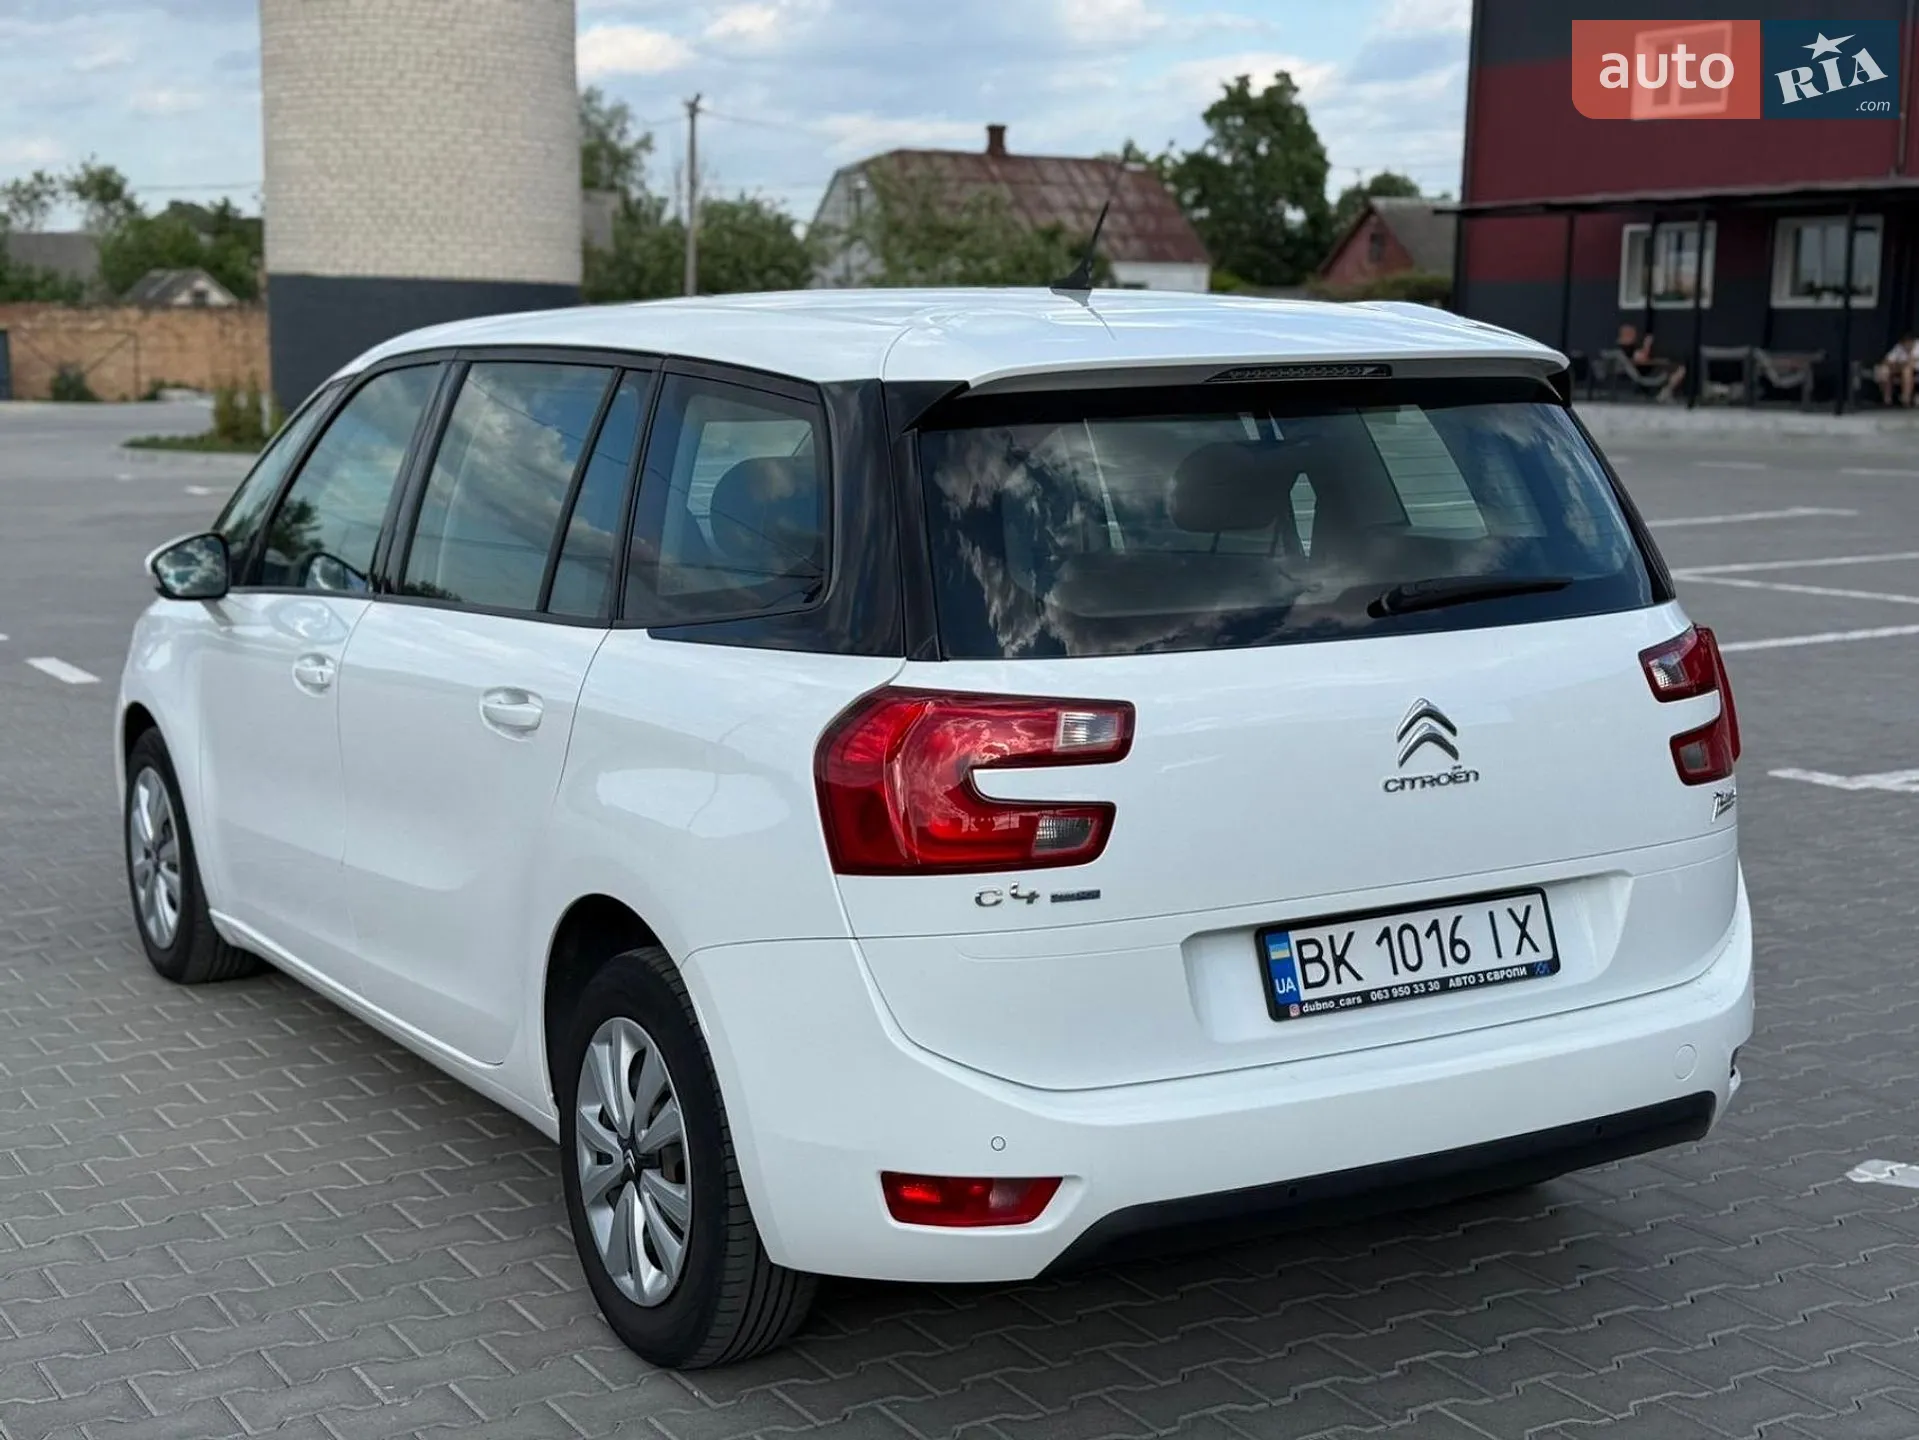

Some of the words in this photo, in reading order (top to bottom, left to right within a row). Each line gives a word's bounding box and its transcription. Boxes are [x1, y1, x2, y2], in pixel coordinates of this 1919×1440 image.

[1295, 931, 1364, 989] BK
[1375, 914, 1471, 976] 1016
[1488, 904, 1540, 959] IX
[1275, 976, 1297, 994] UA
[1448, 975, 1476, 988] АВТО
[1486, 966, 1527, 982] ЄВРОПИ
[1302, 995, 1362, 1013] dubno_cars
[1370, 989, 1390, 1001] 063
[1391, 985, 1411, 998] 950
[1413, 983, 1426, 993] 33
[1427, 981, 1440, 992] 30
